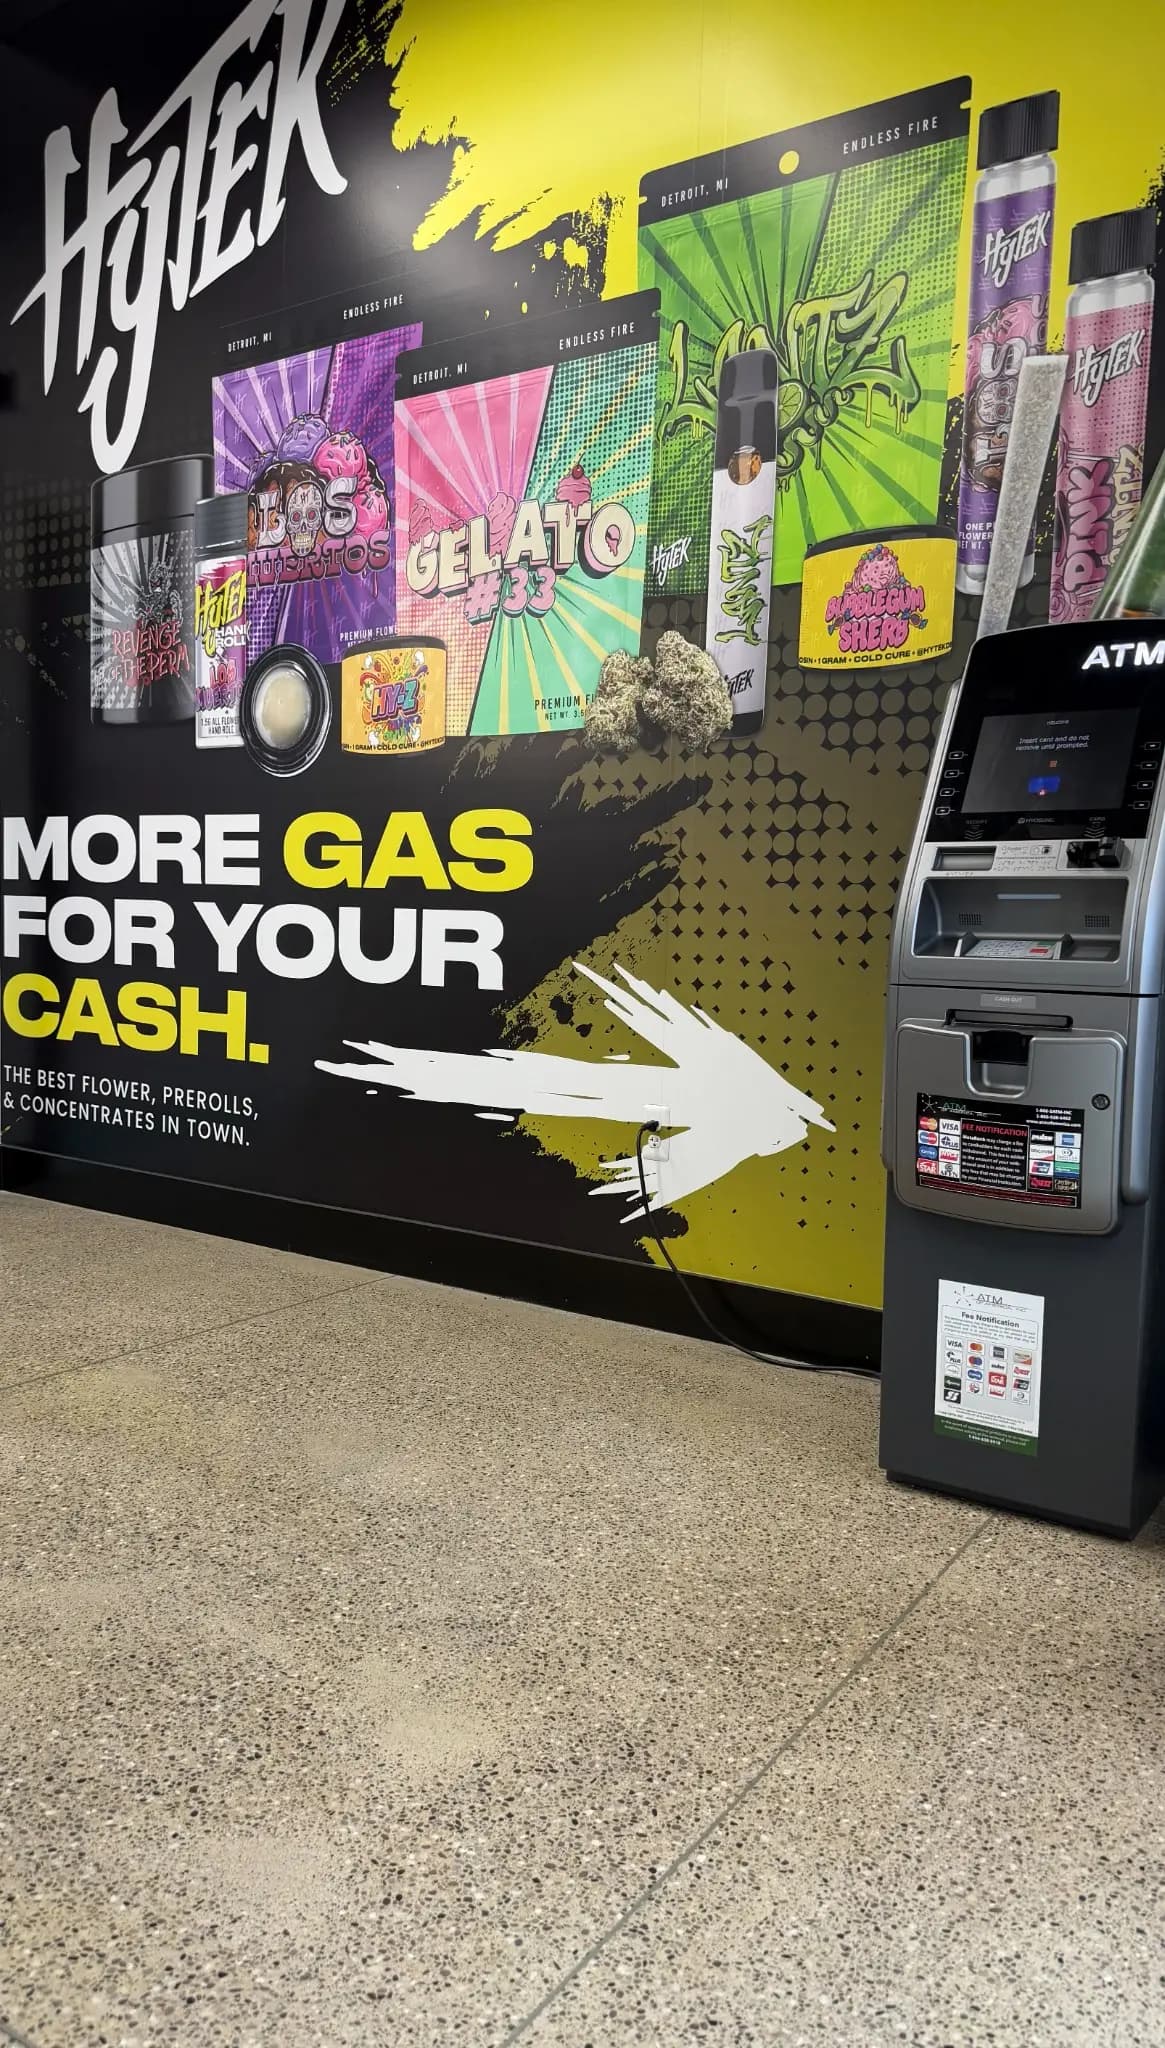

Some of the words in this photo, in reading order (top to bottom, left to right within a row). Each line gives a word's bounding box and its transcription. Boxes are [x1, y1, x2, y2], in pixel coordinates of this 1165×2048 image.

[843, 127, 901, 155] ENDLESS
[908, 116, 939, 136] FIRE
[716, 177, 729, 192] MI
[343, 302, 380, 320] ENDLESS
[384, 294, 404, 309] FIRE
[263, 331, 273, 344] MI
[559, 328, 605, 351] ENDLESS
[611, 321, 636, 338] FIRE
[457, 362, 468, 375] MI
[965, 523, 984, 531] ONE
[1062, 457, 1114, 595] PINK
[247, 530, 391, 587] UERTOS
[406, 498, 637, 600] GELATO
[464, 566, 557, 625] #33
[825, 585, 926, 623] BUBBLEGUM
[112, 620, 183, 660] REVENGE
[340, 629, 373, 641] PREMIUM
[822, 656, 847, 665] GRAM
[853, 653, 883, 663] COLD
[885, 650, 911, 661] CURE
[1081, 640, 1165, 670] ATM
[535, 695, 581, 710] PREMIUM
[376, 743, 397, 751] COLD
[399, 742, 416, 750] CURE
[3, 813, 261, 886] MORE
[283, 808, 535, 893] GAS
[3, 894, 176, 969] FOR
[193, 900, 504, 991] YOUR
[2, 972, 270, 1065] CASH.
[3, 1064, 32, 1086] THE
[37, 1069, 76, 1091] BEST
[82, 1075, 156, 1105] FLOWER,
[163, 1086, 260, 1121] PREROLLS,
[3, 1090, 16, 1109] &
[19, 1094, 155, 1132] CONCENTRATES
[162, 1116, 180, 1135] IN
[187, 1120, 251, 1147] TOWN.
[941, 1122, 959, 1132] VISA
[961, 1123, 975, 1131] FEE
[975, 1125, 1028, 1137] NOTIFICATION
[961, 1311, 975, 1320] Fee
[976, 1315, 1020, 1328] Notification
[947, 1340, 962, 1348] VISA
